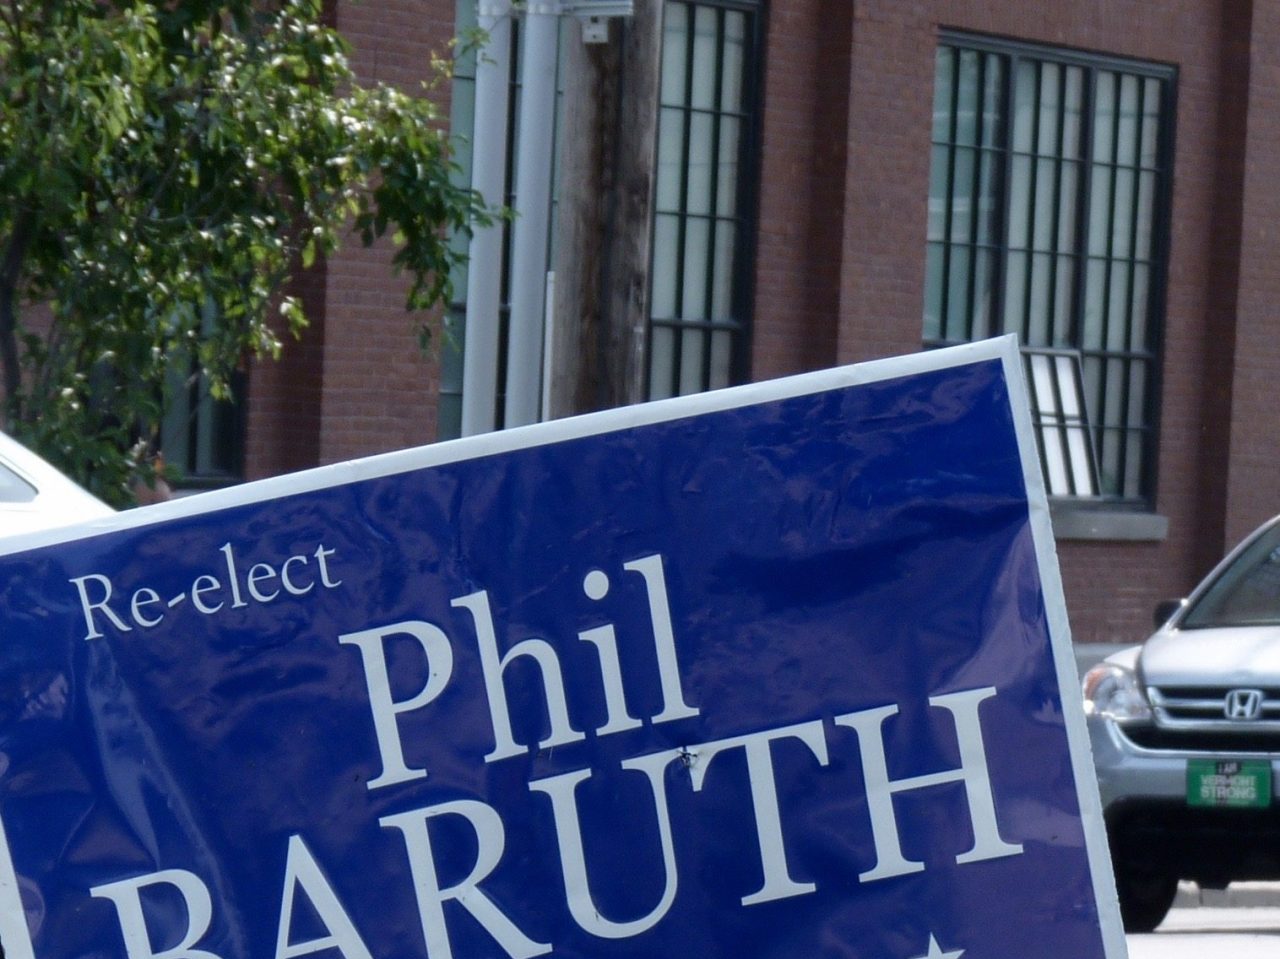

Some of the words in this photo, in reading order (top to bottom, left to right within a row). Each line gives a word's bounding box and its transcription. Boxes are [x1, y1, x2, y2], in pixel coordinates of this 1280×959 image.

[69, 543, 341, 640] Re-elect
[339, 554, 699, 789] Phil
[1200, 774, 1257, 787] VERMONT
[1200, 786, 1257, 799] STRONG
